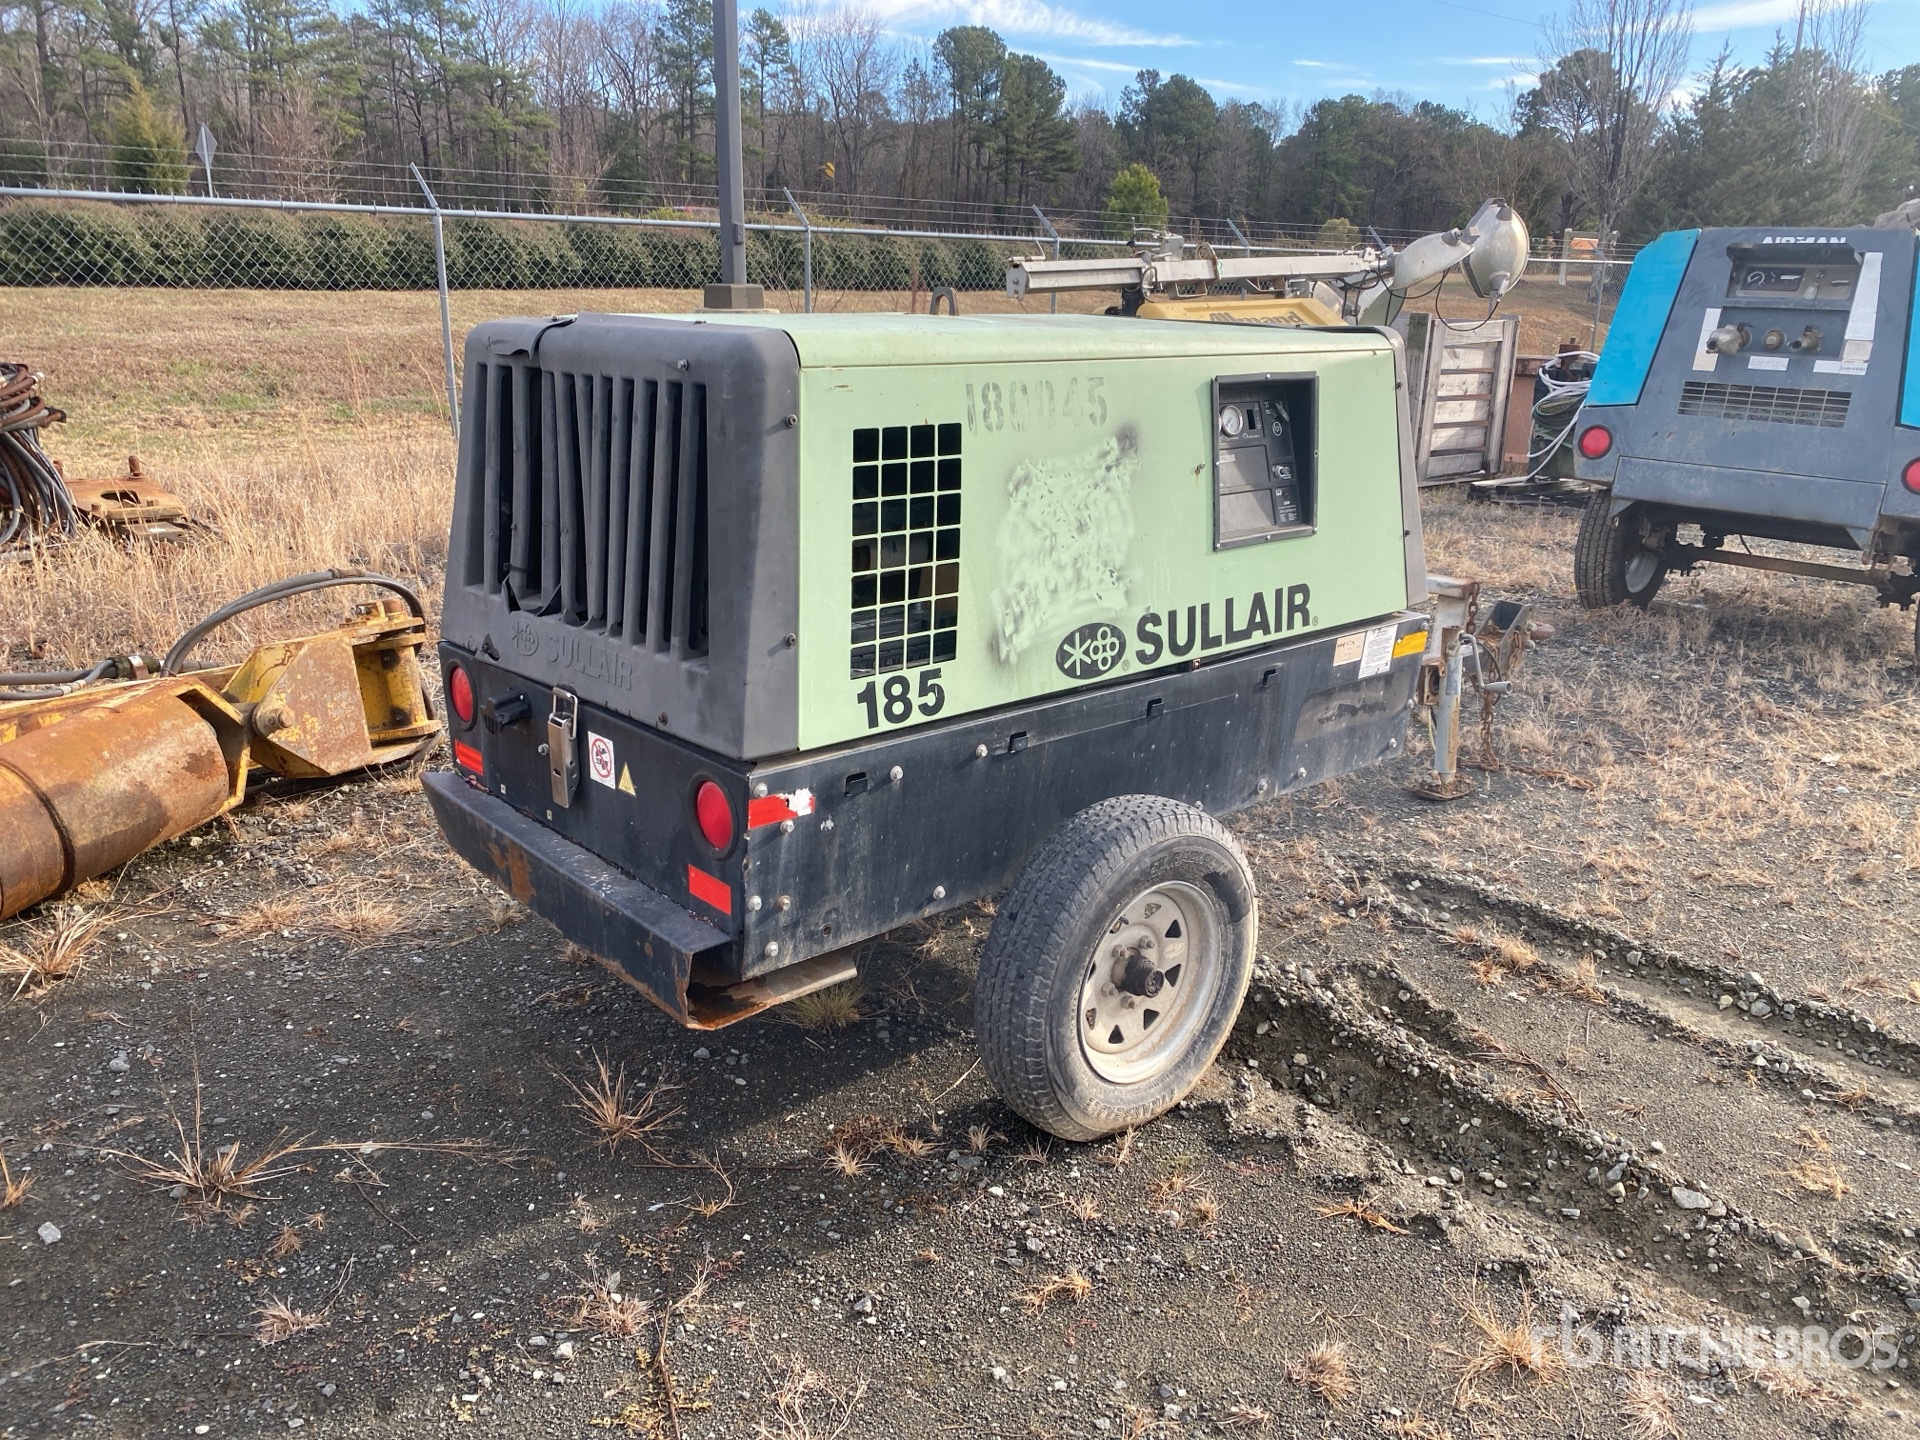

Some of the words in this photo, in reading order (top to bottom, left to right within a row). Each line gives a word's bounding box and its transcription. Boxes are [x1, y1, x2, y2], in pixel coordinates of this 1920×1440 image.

[1135, 583, 1311, 665] SULLAIR
[546, 635, 633, 691] SULLAIR
[857, 667, 945, 729] 185
